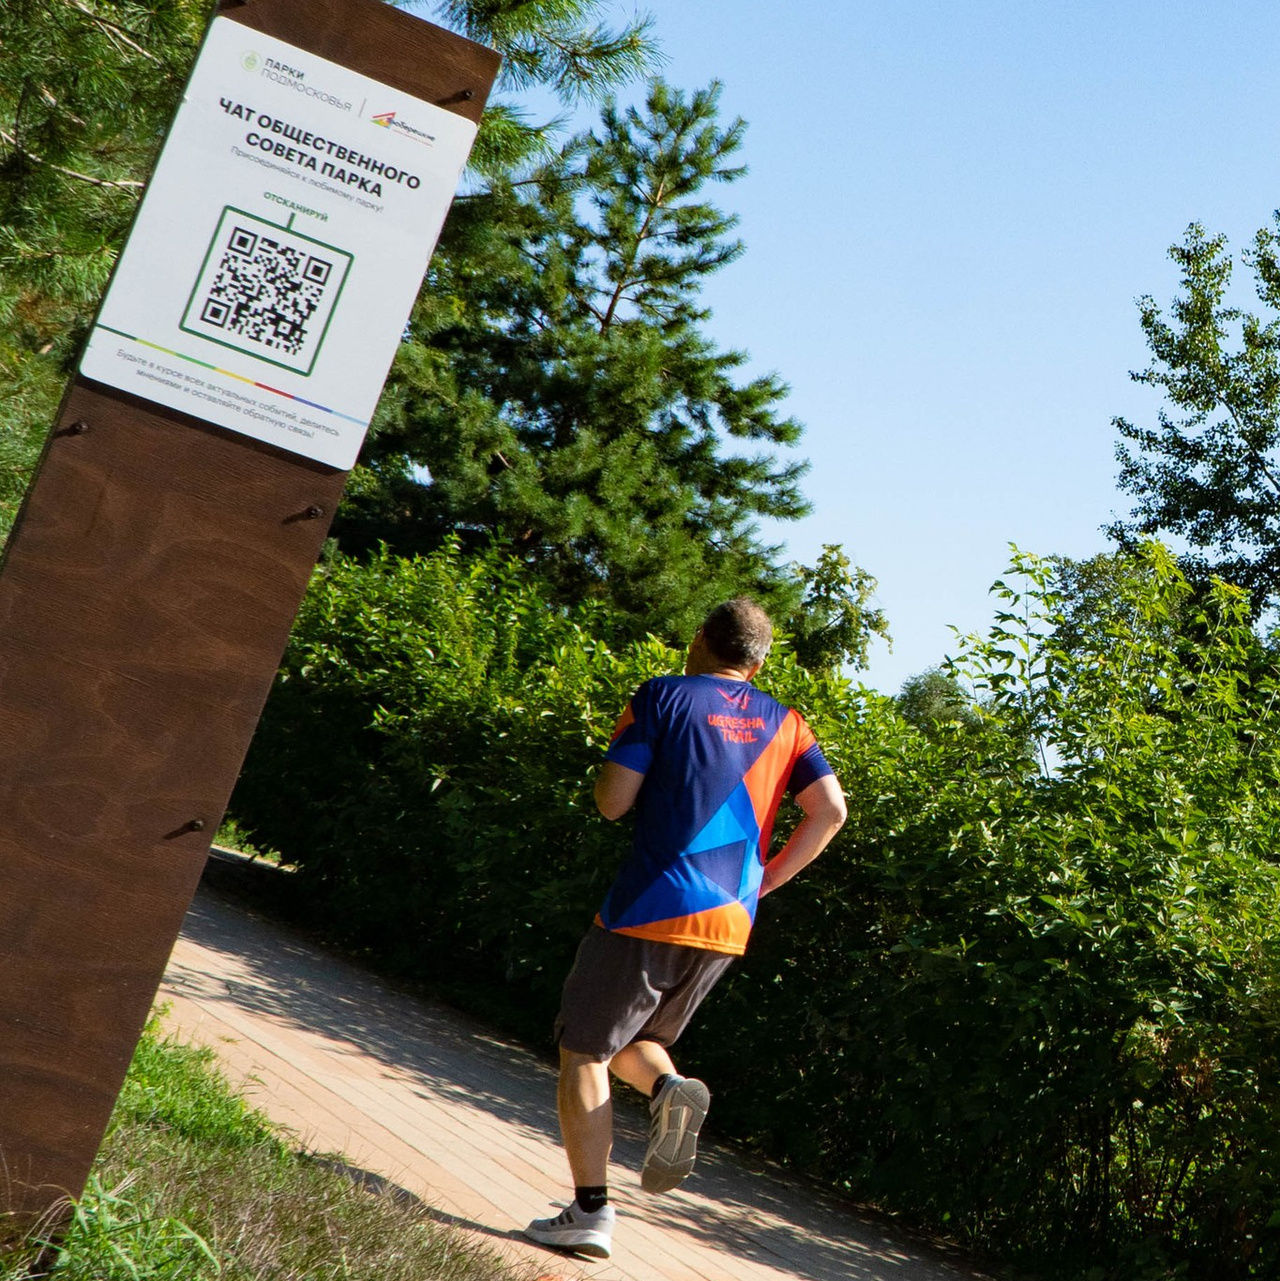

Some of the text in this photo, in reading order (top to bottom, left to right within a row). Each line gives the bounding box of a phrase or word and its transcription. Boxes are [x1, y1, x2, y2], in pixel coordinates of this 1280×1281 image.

[261, 68, 352, 112] ПОДМОСКОВЬЯ
[265, 58, 305, 81] ПАРКИ
[219, 97, 421, 189] ЧАТ ОБЩЕСТВЕННОГО
[246, 132, 382, 198] СОВЕТА ПАРКА
[231, 145, 300, 179] Присоединяйся
[308, 177, 355, 202] любимому
[354, 197, 384, 213] парку!
[263, 191, 328, 222] ОТСКАНИРУЙ
[116, 348, 147, 366] Будьте
[156, 365, 183, 380] курсе
[184, 374, 204, 387] всех
[206, 383, 256, 406] актуальных
[299, 418, 340, 437] делитесь
[136, 369, 182, 389] мнениями
[191, 390, 241, 412] оставляйте
[242, 408, 286, 429] обратную
[707, 714, 766, 730] UGRESHA
[721, 727, 758, 744] TRAIL
